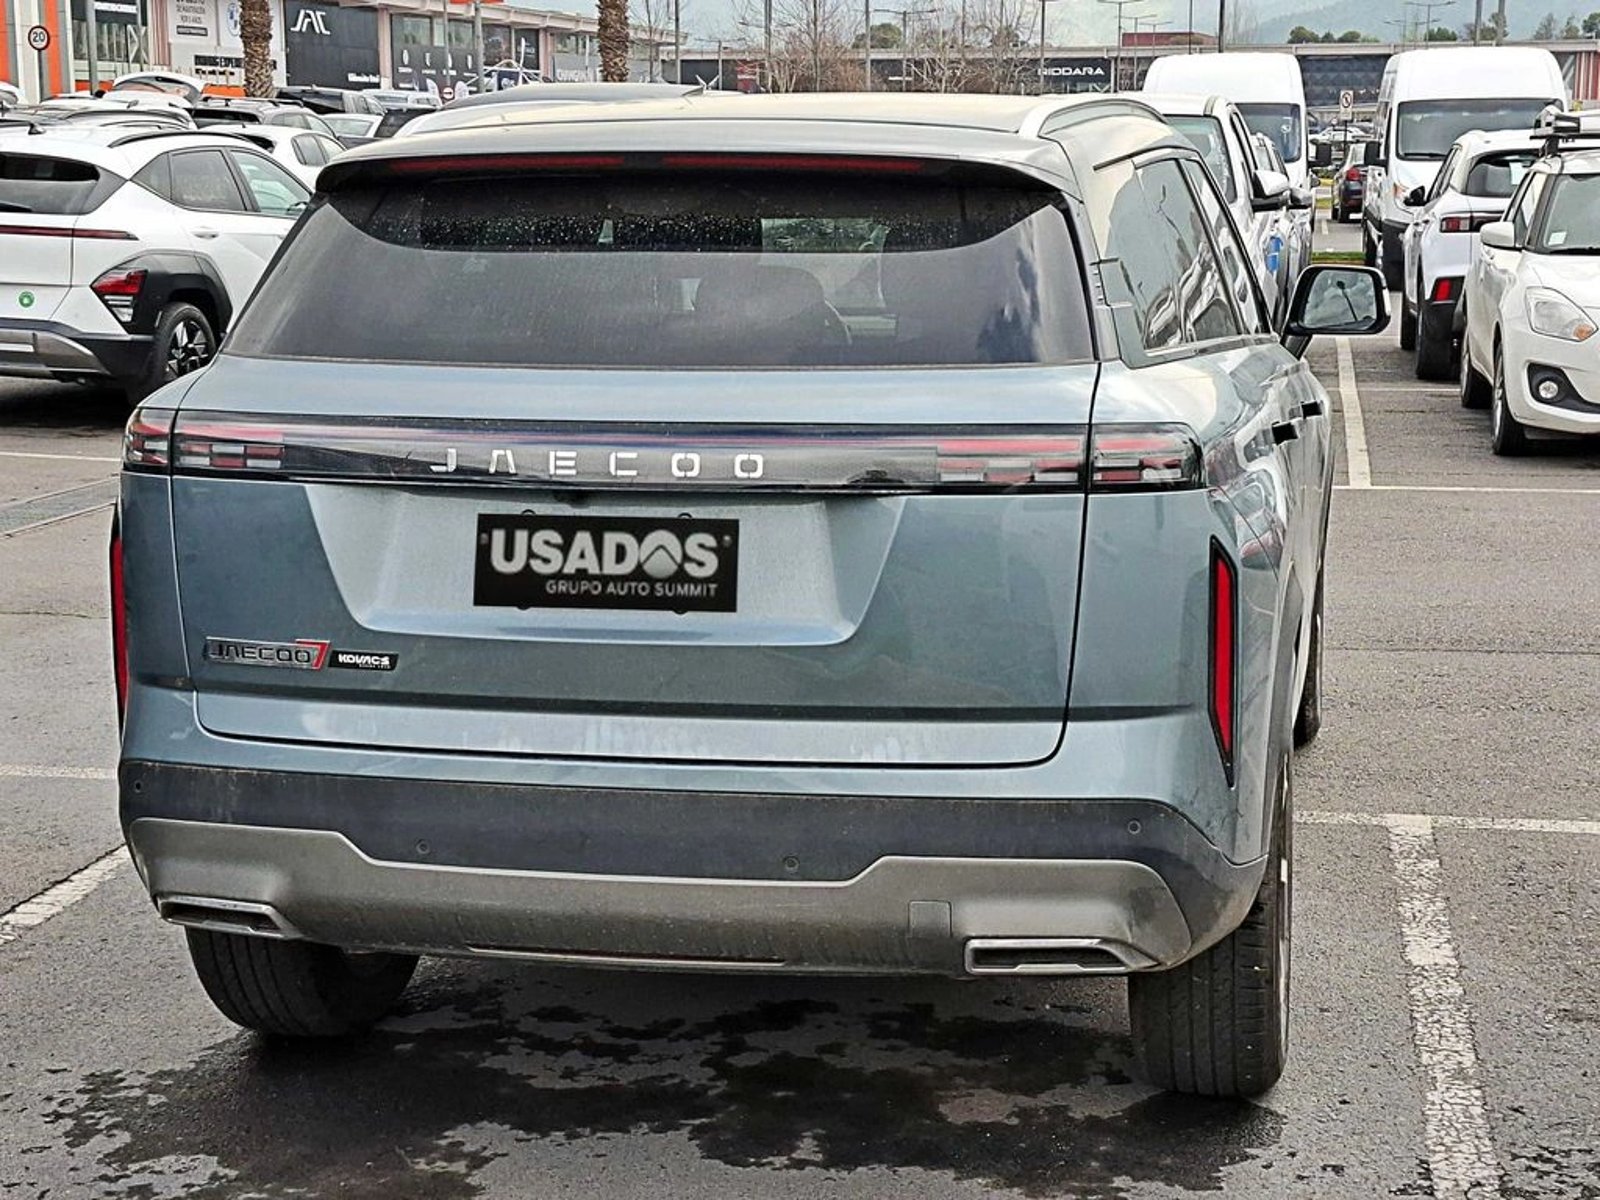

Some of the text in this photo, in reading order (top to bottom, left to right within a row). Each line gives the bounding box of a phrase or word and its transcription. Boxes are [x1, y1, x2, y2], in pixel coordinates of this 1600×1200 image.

[32, 31, 45, 43] 20
[430, 448, 764, 479] JAECOO
[490, 529, 719, 579] USADOS
[546, 579, 719, 598] GRUPO AUTO SUMMIT
[338, 653, 390, 665] KOVACS
